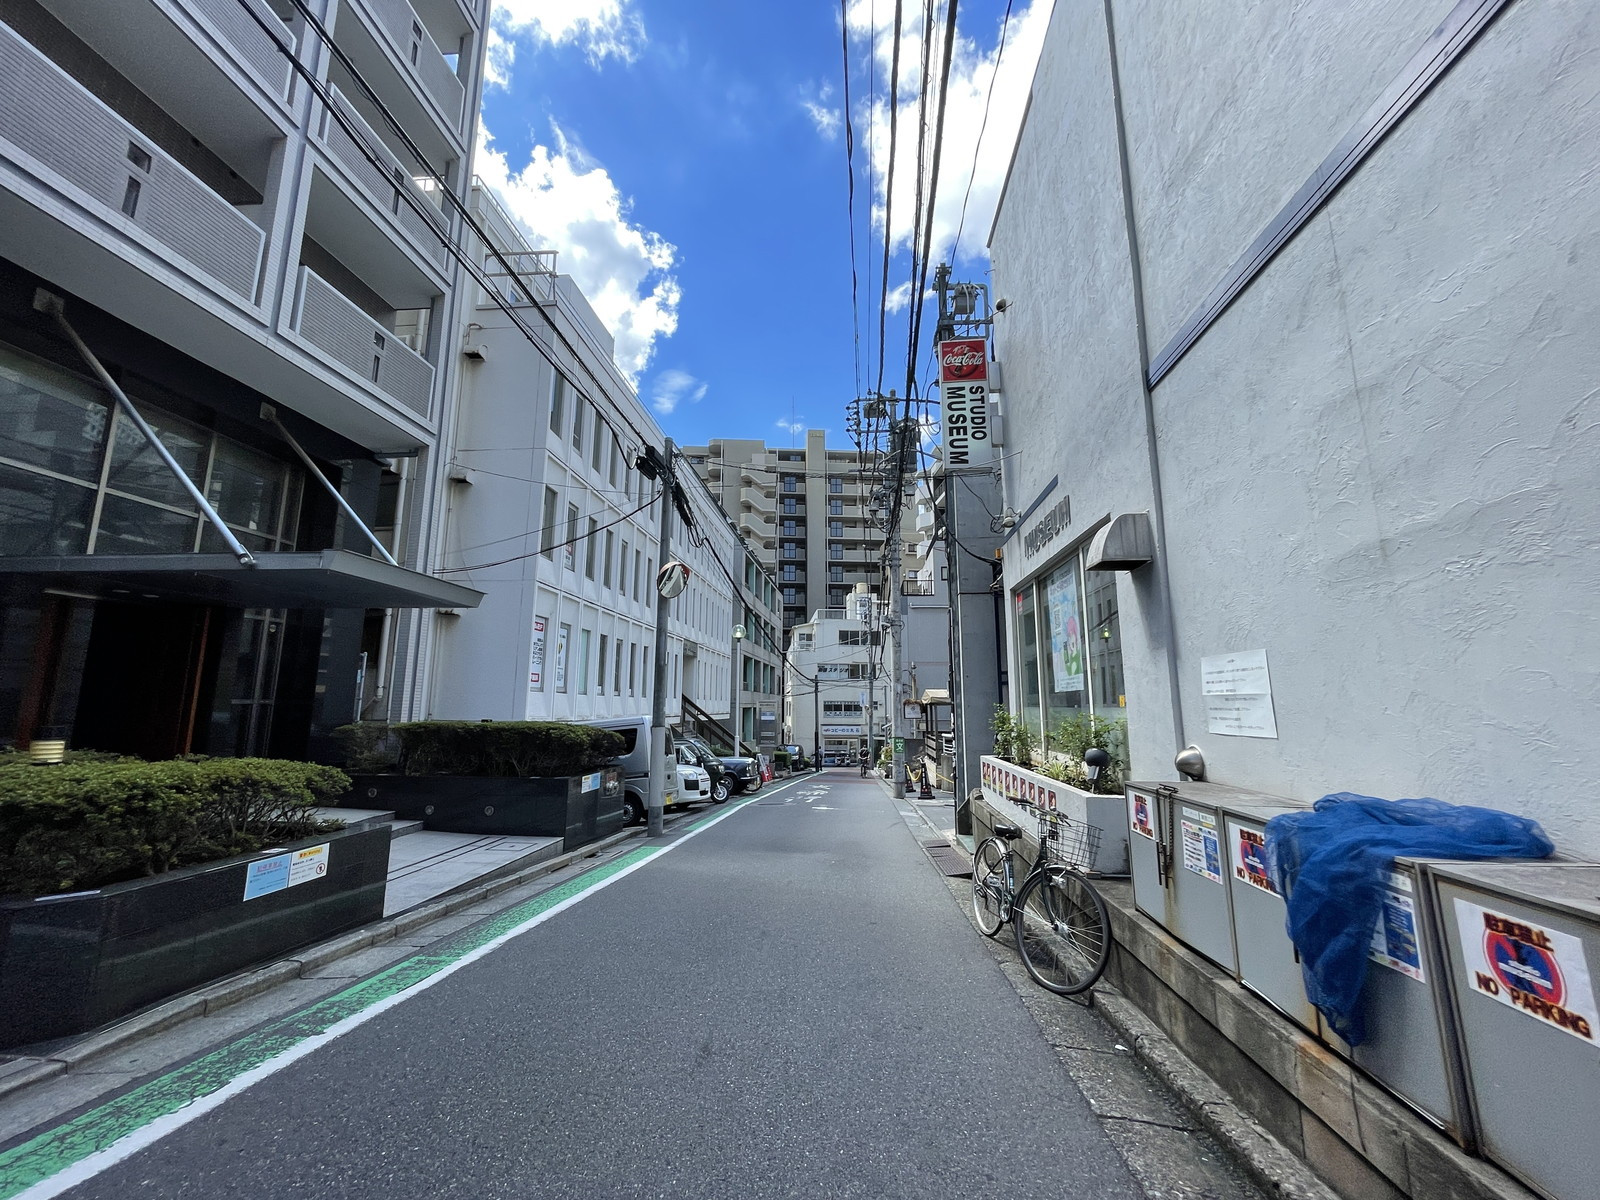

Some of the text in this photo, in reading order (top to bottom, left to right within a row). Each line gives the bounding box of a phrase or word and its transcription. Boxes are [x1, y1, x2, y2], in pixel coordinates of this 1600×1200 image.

[943, 352, 984, 366] Coca-Cola
[947, 386, 969, 464] MUSEUM
[969, 385, 988, 440] STUDIO
[1024, 494, 1071, 559] MUSEUM
[1236, 866, 1245, 879] NO
[1475, 970, 1594, 1040] NO PARKING
